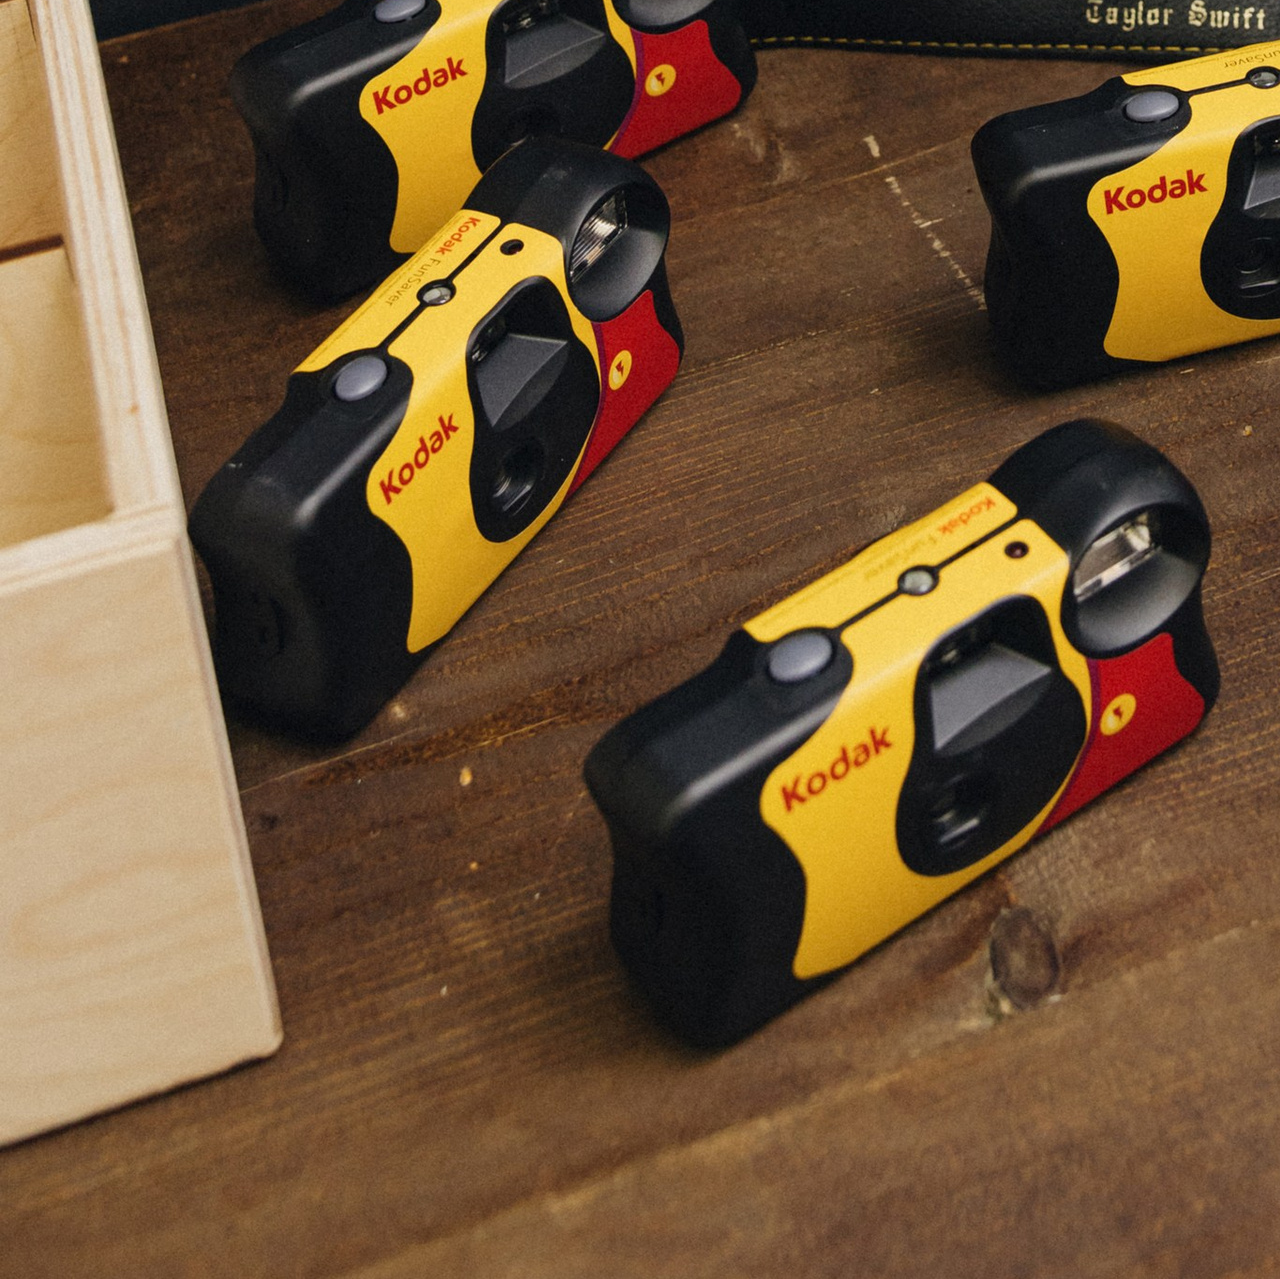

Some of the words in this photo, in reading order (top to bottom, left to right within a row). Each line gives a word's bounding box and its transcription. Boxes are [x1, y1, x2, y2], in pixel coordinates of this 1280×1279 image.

[1188, 0, 1266, 31] Swift
[372, 56, 468, 116] Kodak
[1104, 169, 1208, 215] Kodak
[435, 217, 481, 256] Kodak
[385, 258, 441, 306] FunSaver
[379, 413, 460, 506] Kodak
[938, 496, 996, 535] Kodak
[780, 726, 893, 812] Kodak
